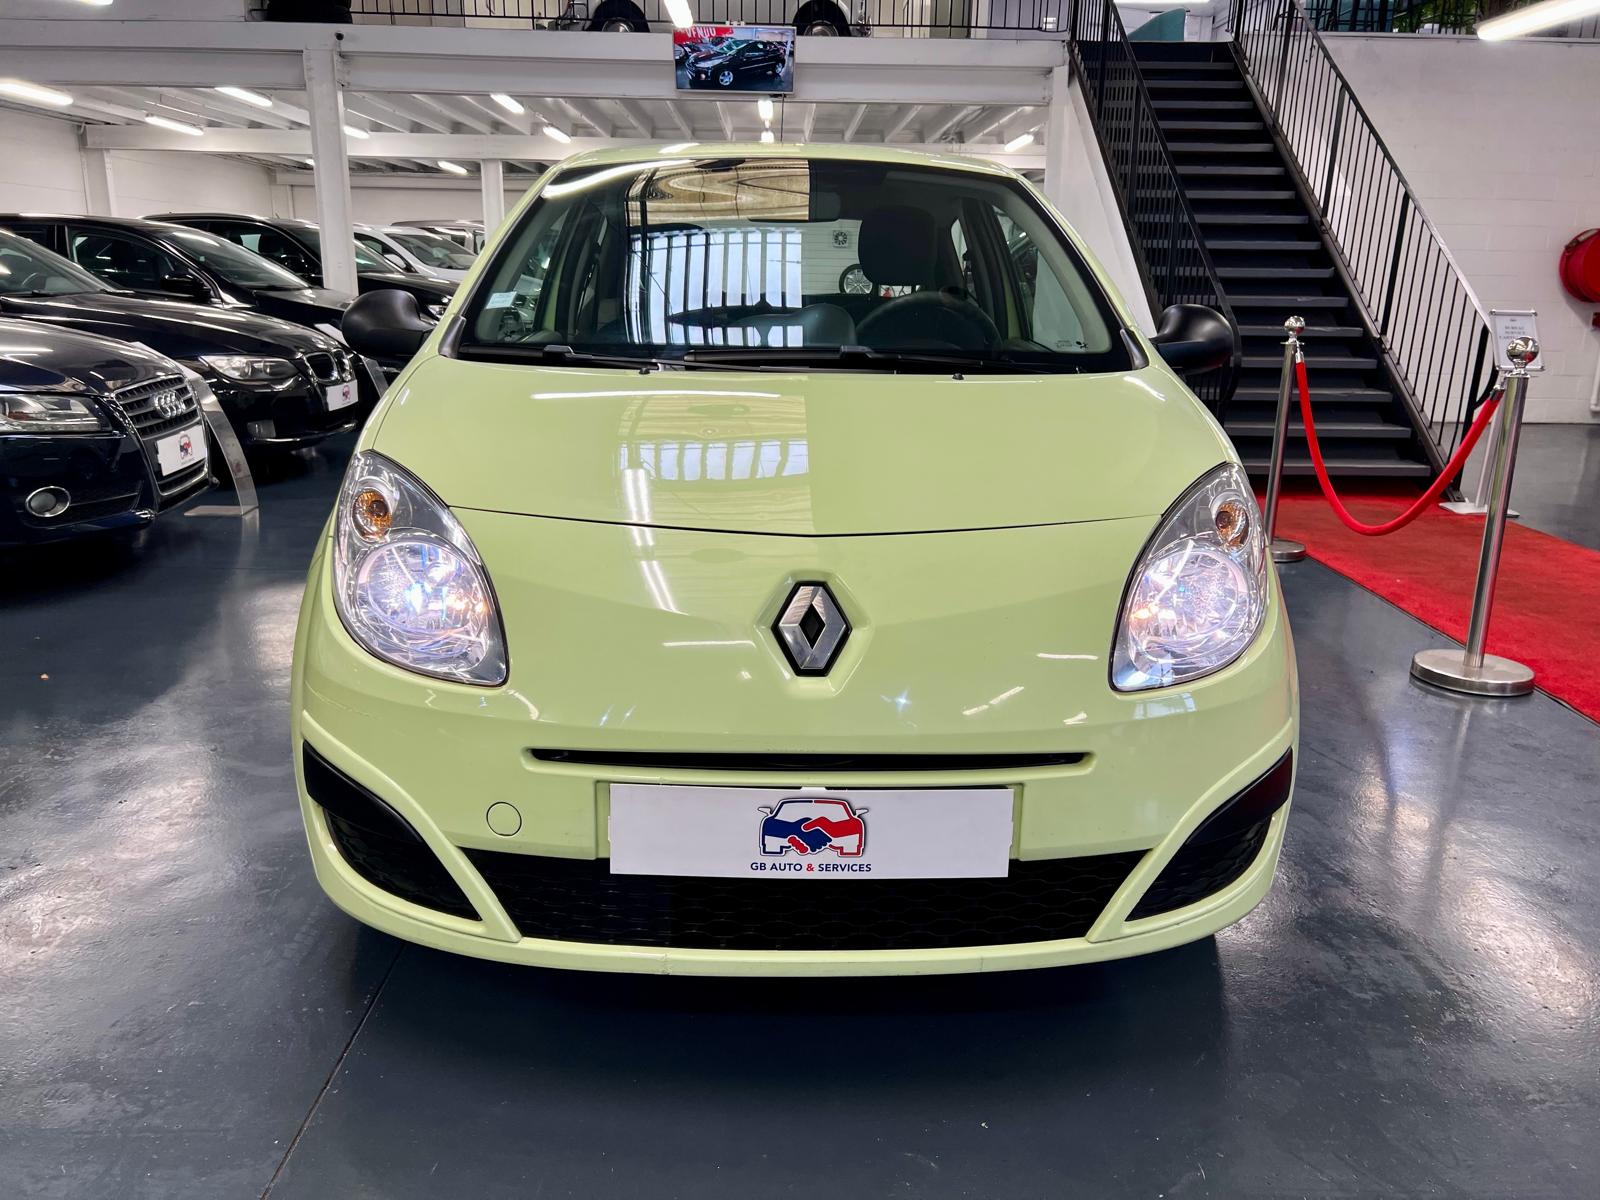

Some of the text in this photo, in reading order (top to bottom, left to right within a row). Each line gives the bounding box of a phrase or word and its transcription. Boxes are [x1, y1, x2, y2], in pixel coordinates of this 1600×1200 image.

[750, 862, 872, 873] GB AUTO & SERVICES
